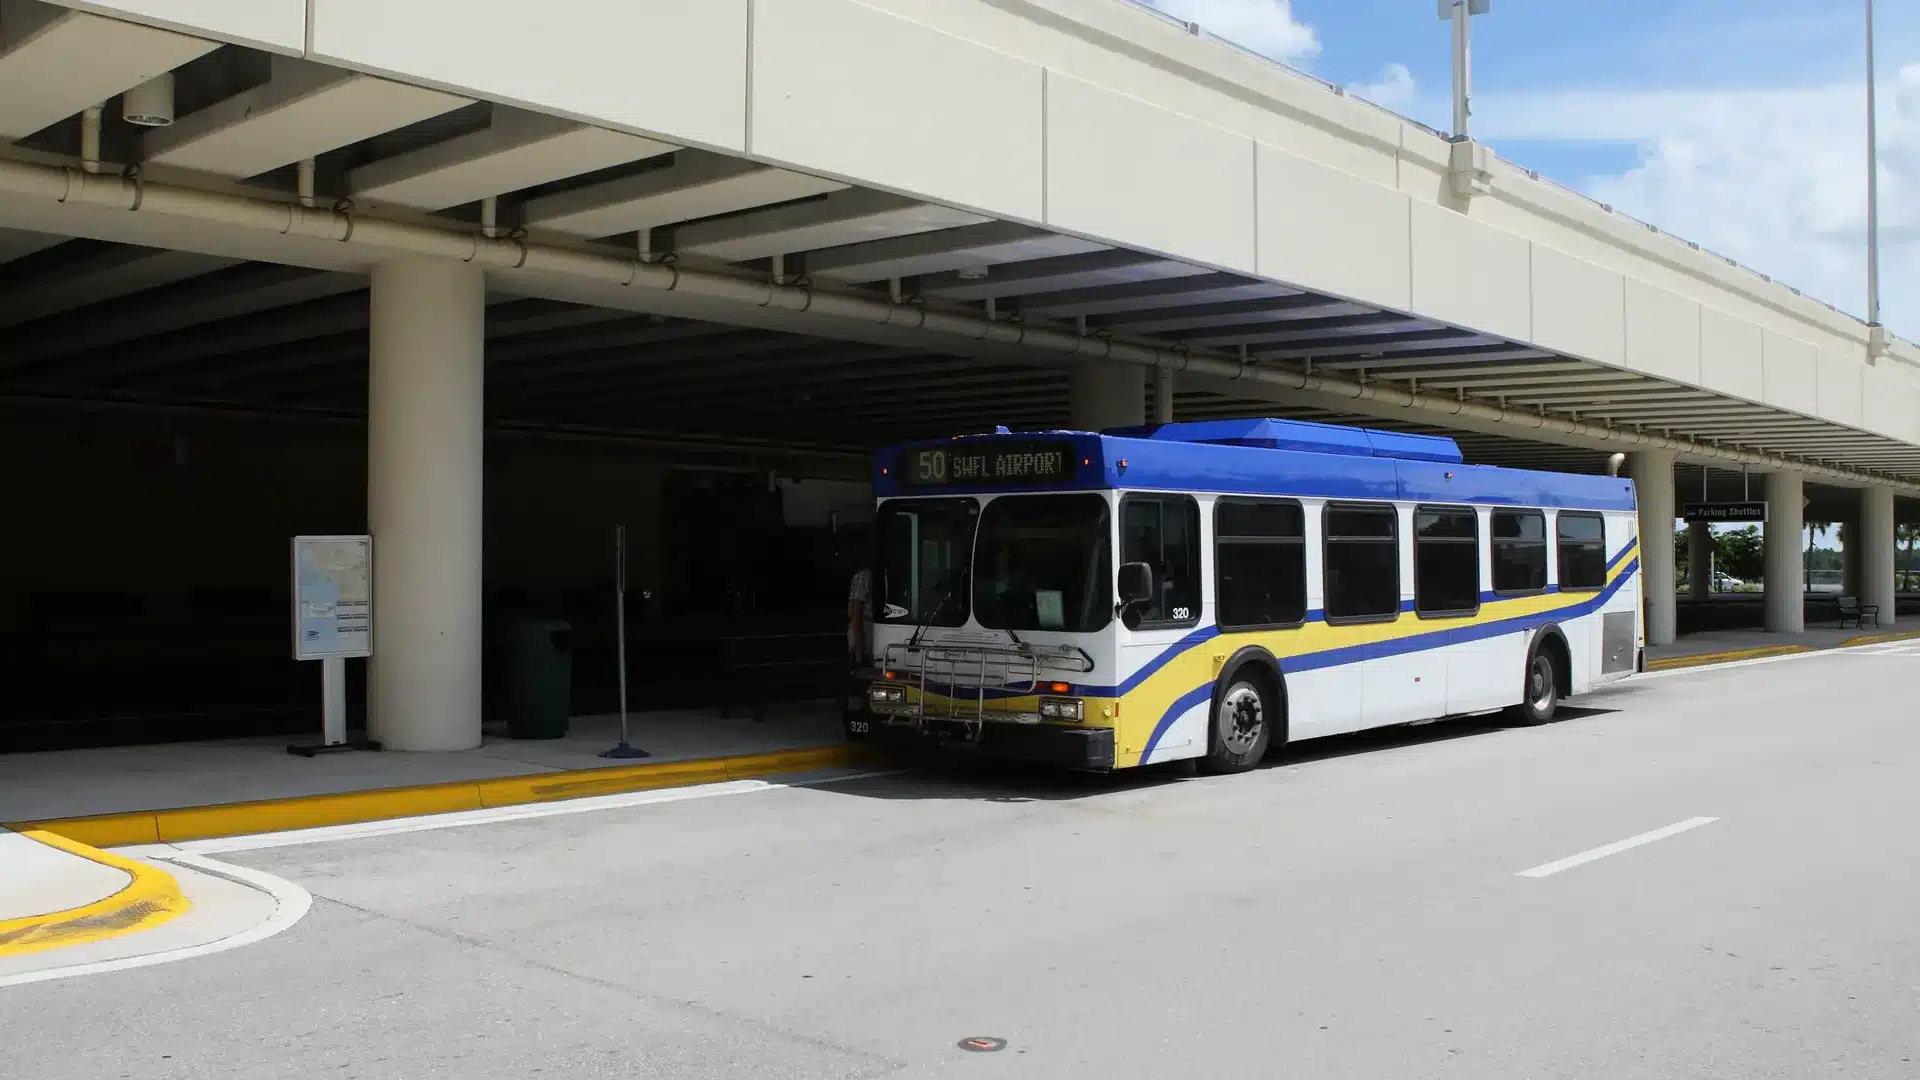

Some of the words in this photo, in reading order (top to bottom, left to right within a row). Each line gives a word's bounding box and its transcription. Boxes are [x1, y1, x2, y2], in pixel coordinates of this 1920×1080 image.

[919, 451, 946, 480] 50
[953, 456, 990, 478] SWFL
[1698, 508, 1727, 518] Parking
[1729, 507, 1761, 516] Shuttles
[1172, 607, 1189, 619] 320
[850, 720, 869, 733] 320
